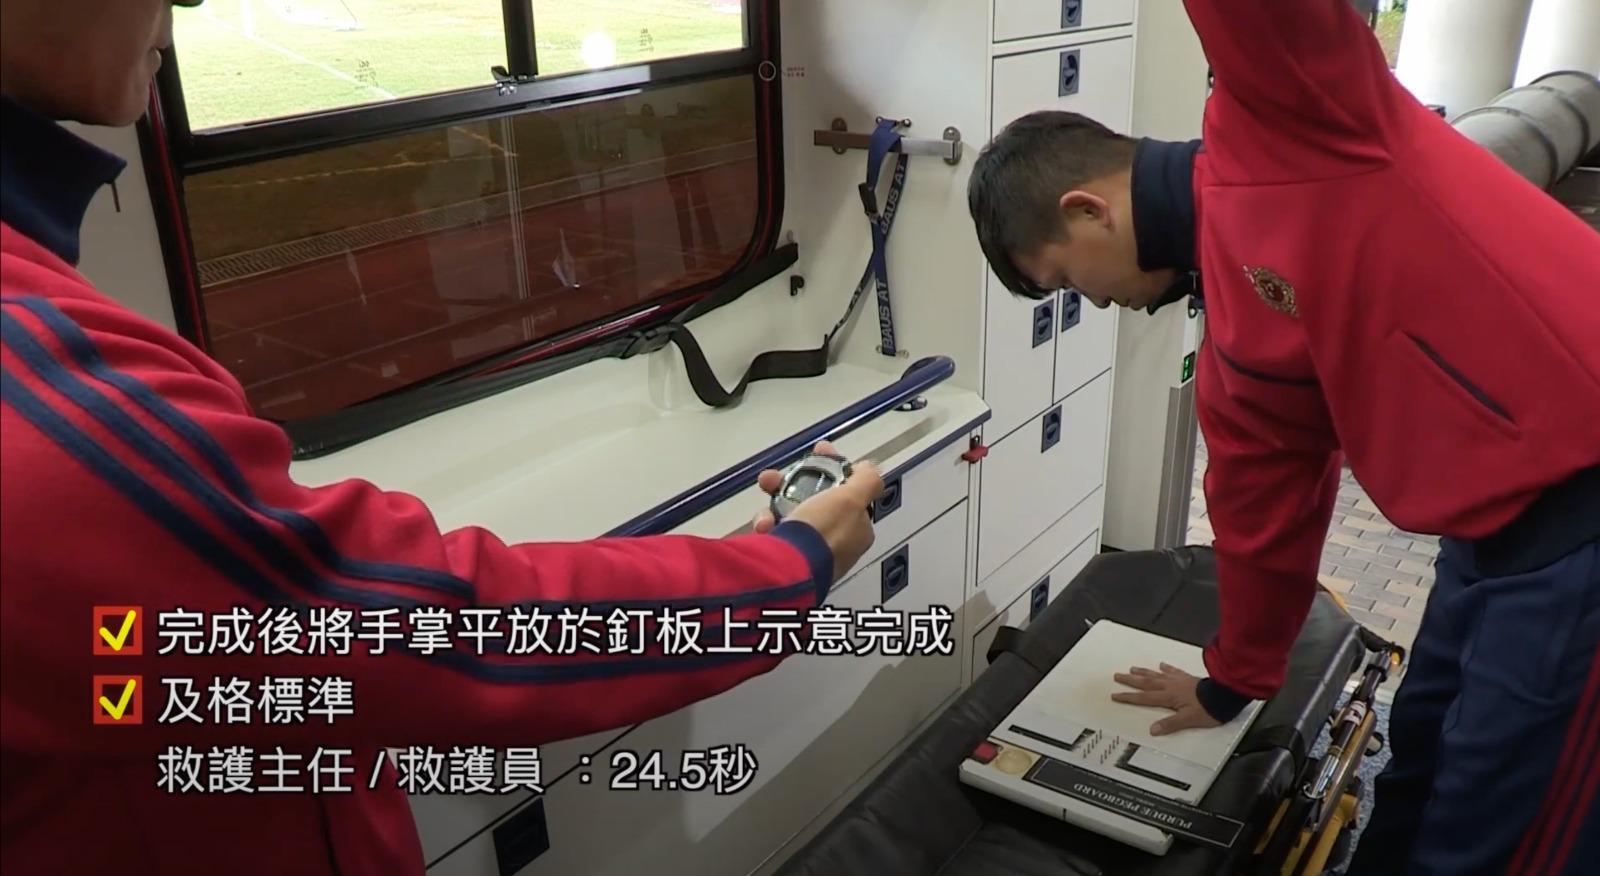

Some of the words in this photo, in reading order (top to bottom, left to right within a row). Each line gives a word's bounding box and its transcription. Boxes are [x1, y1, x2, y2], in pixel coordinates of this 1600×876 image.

[881, 188, 900, 235] BAUS
[876, 279, 889, 302] AT
[880, 305, 894, 349] BAUS
[1073, 783, 1141, 813] PEGBOARD
[1140, 807, 1193, 830] PURDUE
